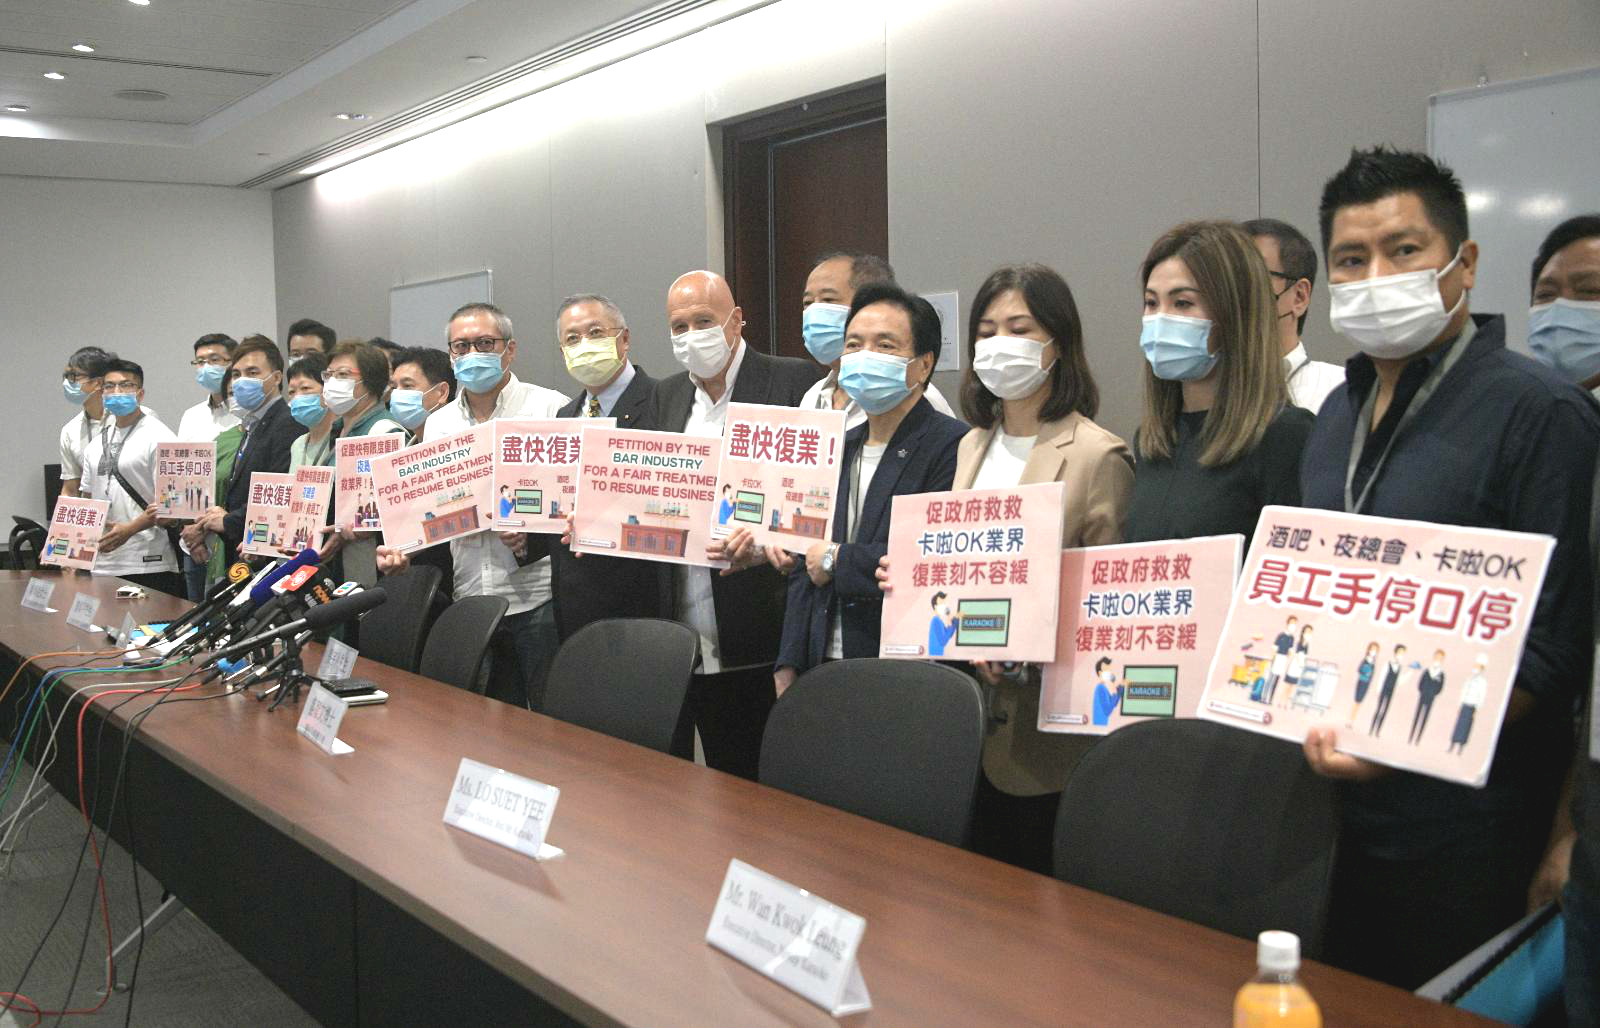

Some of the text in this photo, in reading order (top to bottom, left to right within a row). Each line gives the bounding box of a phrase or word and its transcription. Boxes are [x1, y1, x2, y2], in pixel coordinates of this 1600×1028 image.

[391, 433, 476, 468] PETITION BY THE
[608, 438, 711, 457] PETITION BY THE
[729, 423, 835, 466] 盡快復業！
[159, 460, 212, 476] 員工手停口停
[378, 452, 493, 496] FOR A FAIR TREATMEN
[398, 446, 472, 478] BAR INDUSTRY
[583, 464, 608, 476] FOR
[610, 467, 620, 478] A
[623, 468, 652, 481] FAIR
[613, 452, 703, 470] BAR INDUSTRY
[387, 495, 401, 506] TO
[403, 481, 444, 501] RESUME
[591, 480, 607, 491] TO
[609, 482, 660, 496] RESUME
[56, 505, 104, 526] 盡快復業！
[926, 494, 1023, 525] 促政府救救
[917, 527, 1024, 555] 卡啦OK業界
[1265, 523, 1527, 582] 酒吧、夜總會、卡啦OK
[912, 559, 1029, 587] 復業刻不容緩
[1091, 553, 1192, 585] 促政府救救
[1083, 588, 1193, 618] 卡啦OK業界
[1248, 558, 1518, 641] 員工手停口停
[1075, 622, 1198, 652] 復業刻不容緩
[474, 780, 492, 802] LO
[491, 787, 522, 813] SUET
[522, 796, 547, 821] YEE
